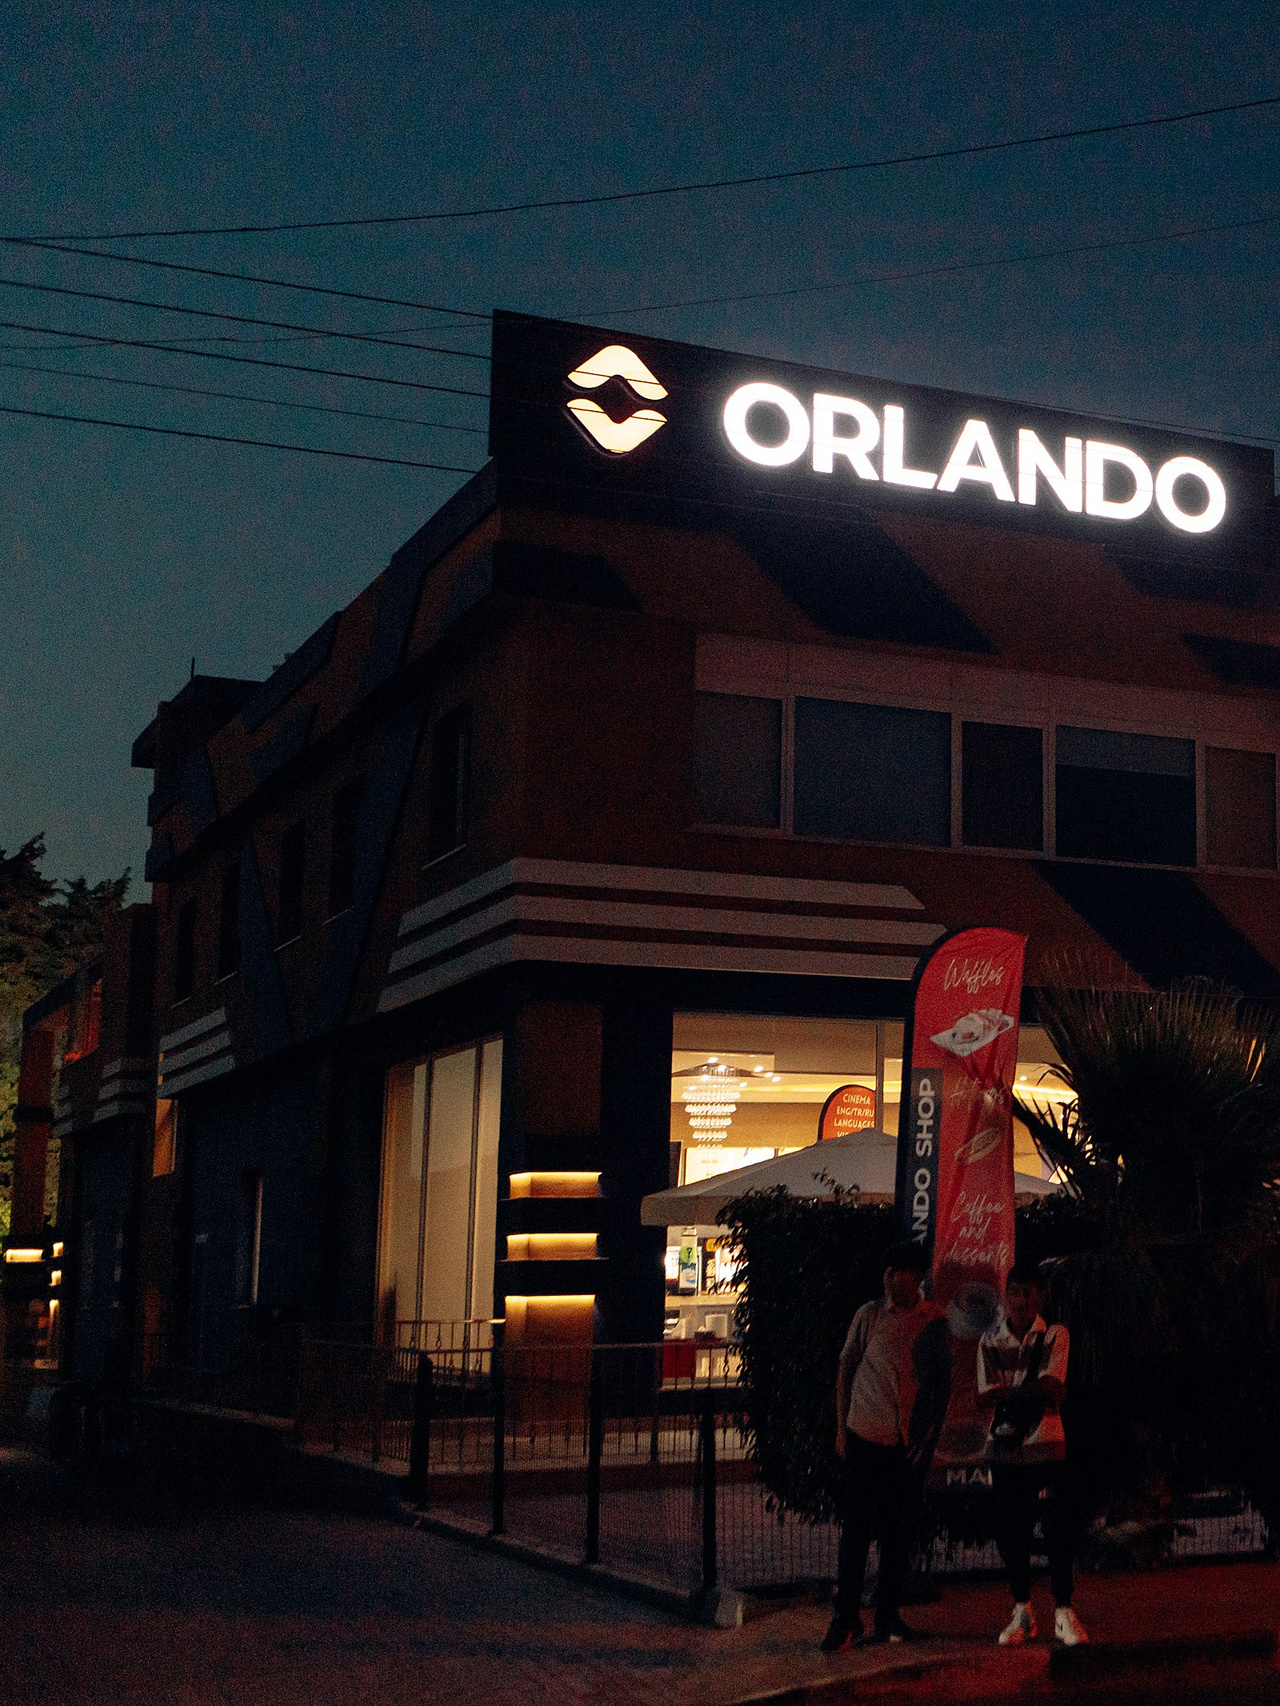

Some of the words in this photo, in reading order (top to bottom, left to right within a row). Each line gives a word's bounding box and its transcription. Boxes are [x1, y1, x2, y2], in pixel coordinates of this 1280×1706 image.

[722, 382, 1226, 534] ORLANDO
[943, 958, 1005, 994] Waffles
[843, 1093, 871, 1105] CINEMA
[915, 1078, 935, 1158] SHOP
[911, 1167, 932, 1246] ANDO
